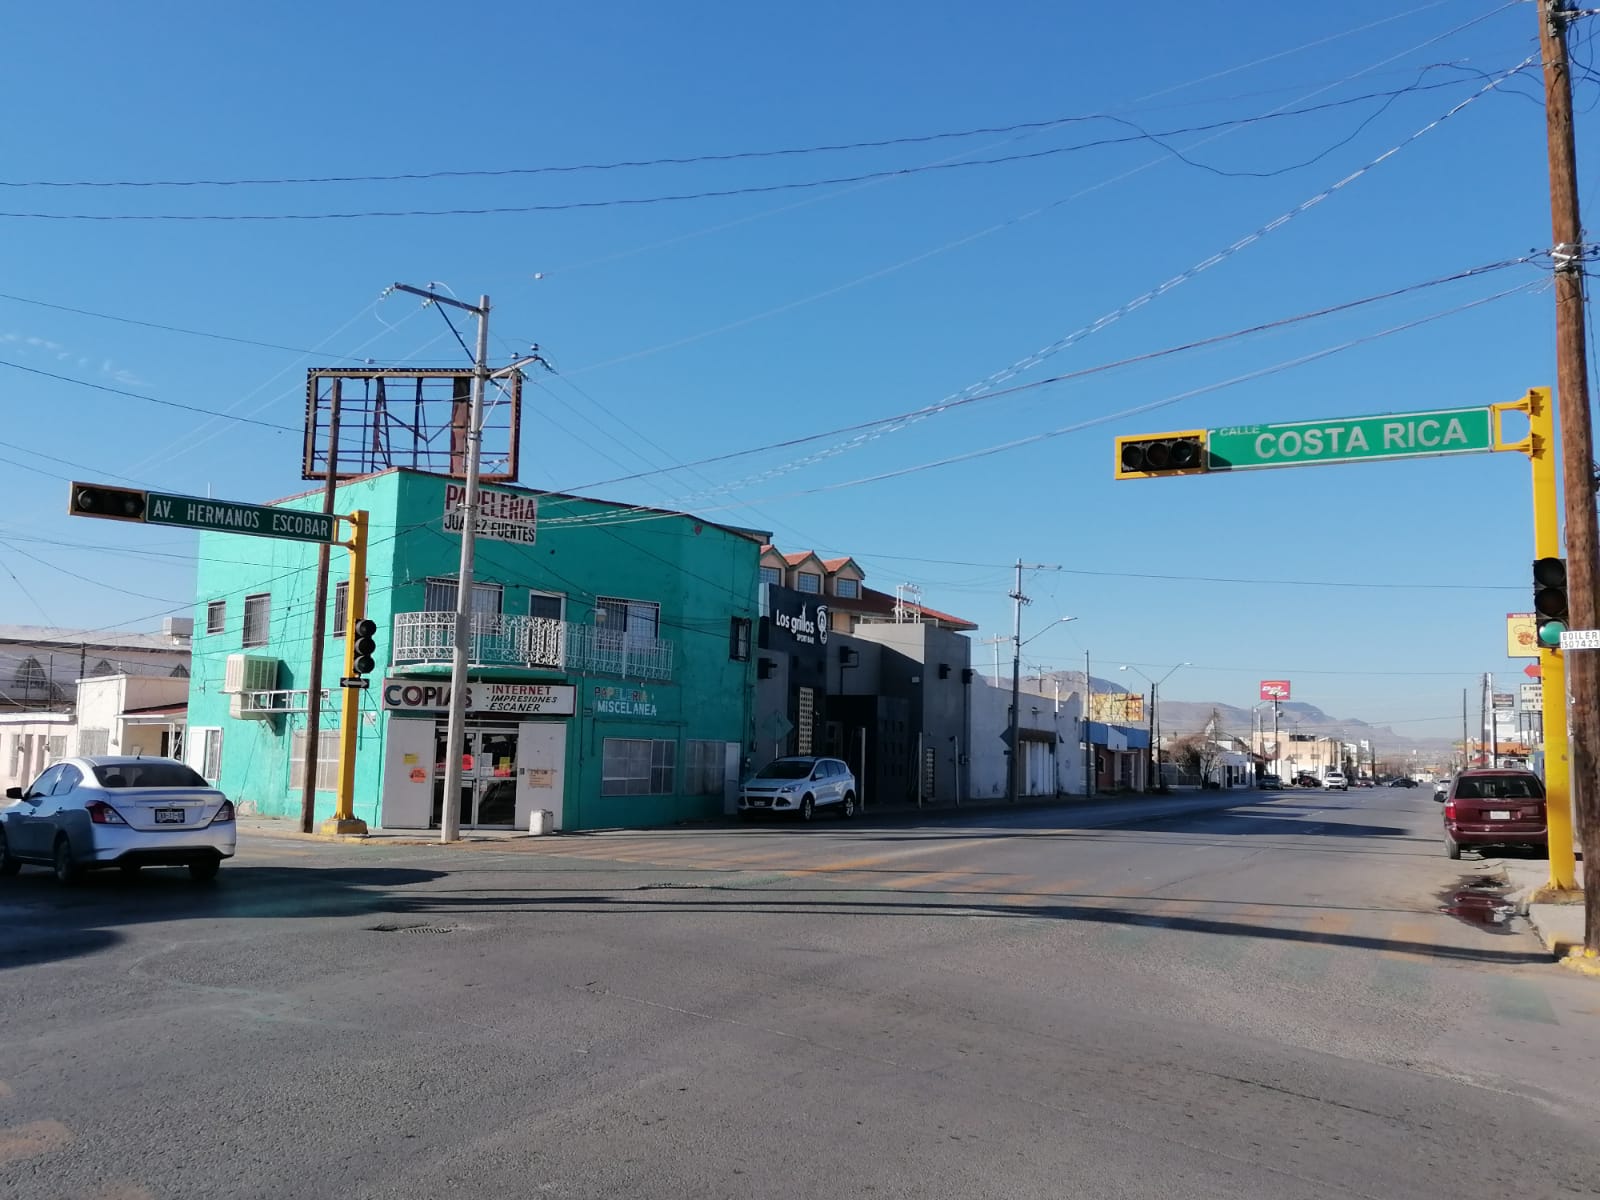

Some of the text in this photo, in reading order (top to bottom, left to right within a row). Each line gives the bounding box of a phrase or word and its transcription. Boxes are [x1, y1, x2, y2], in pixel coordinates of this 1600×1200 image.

[1220, 425, 1260, 437] CALLE
[1255, 418, 1468, 459] COSTA RICA
[446, 484, 535, 520] PAELERIA
[154, 499, 328, 537] AV. HERMANOS ESCOBAR
[444, 514, 535, 543] JUAEZ FUENTES
[776, 609, 789, 628] Los
[1562, 631, 1598, 641] BOILER
[492, 685, 552, 698] INTERNET
[489, 701, 541, 714] ESCANER
[491, 695, 558, 705] IMPRESIONES
